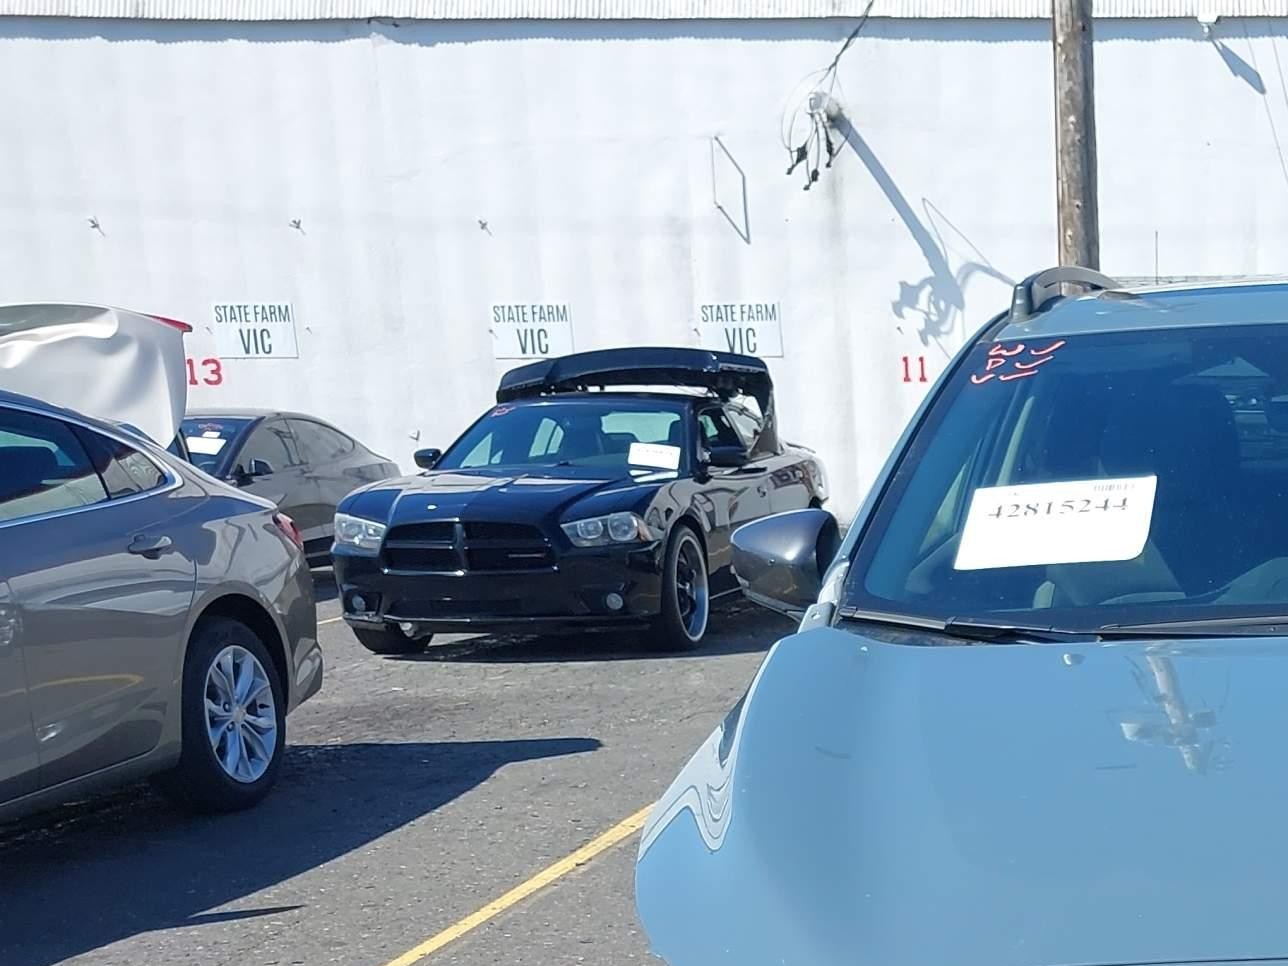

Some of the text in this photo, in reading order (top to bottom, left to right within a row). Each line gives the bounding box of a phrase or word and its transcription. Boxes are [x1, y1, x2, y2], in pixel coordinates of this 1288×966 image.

[214, 304, 291, 323] STATE FARM
[493, 304, 568, 323] STATE FARM
[701, 303, 777, 322] STATE FARM
[239, 328, 272, 354] VIC
[517, 328, 549, 354] VIC
[725, 327, 757, 354] VIC
[186, 358, 223, 386] 13
[901, 356, 928, 383] 11
[987, 497, 1129, 519] 42815244
